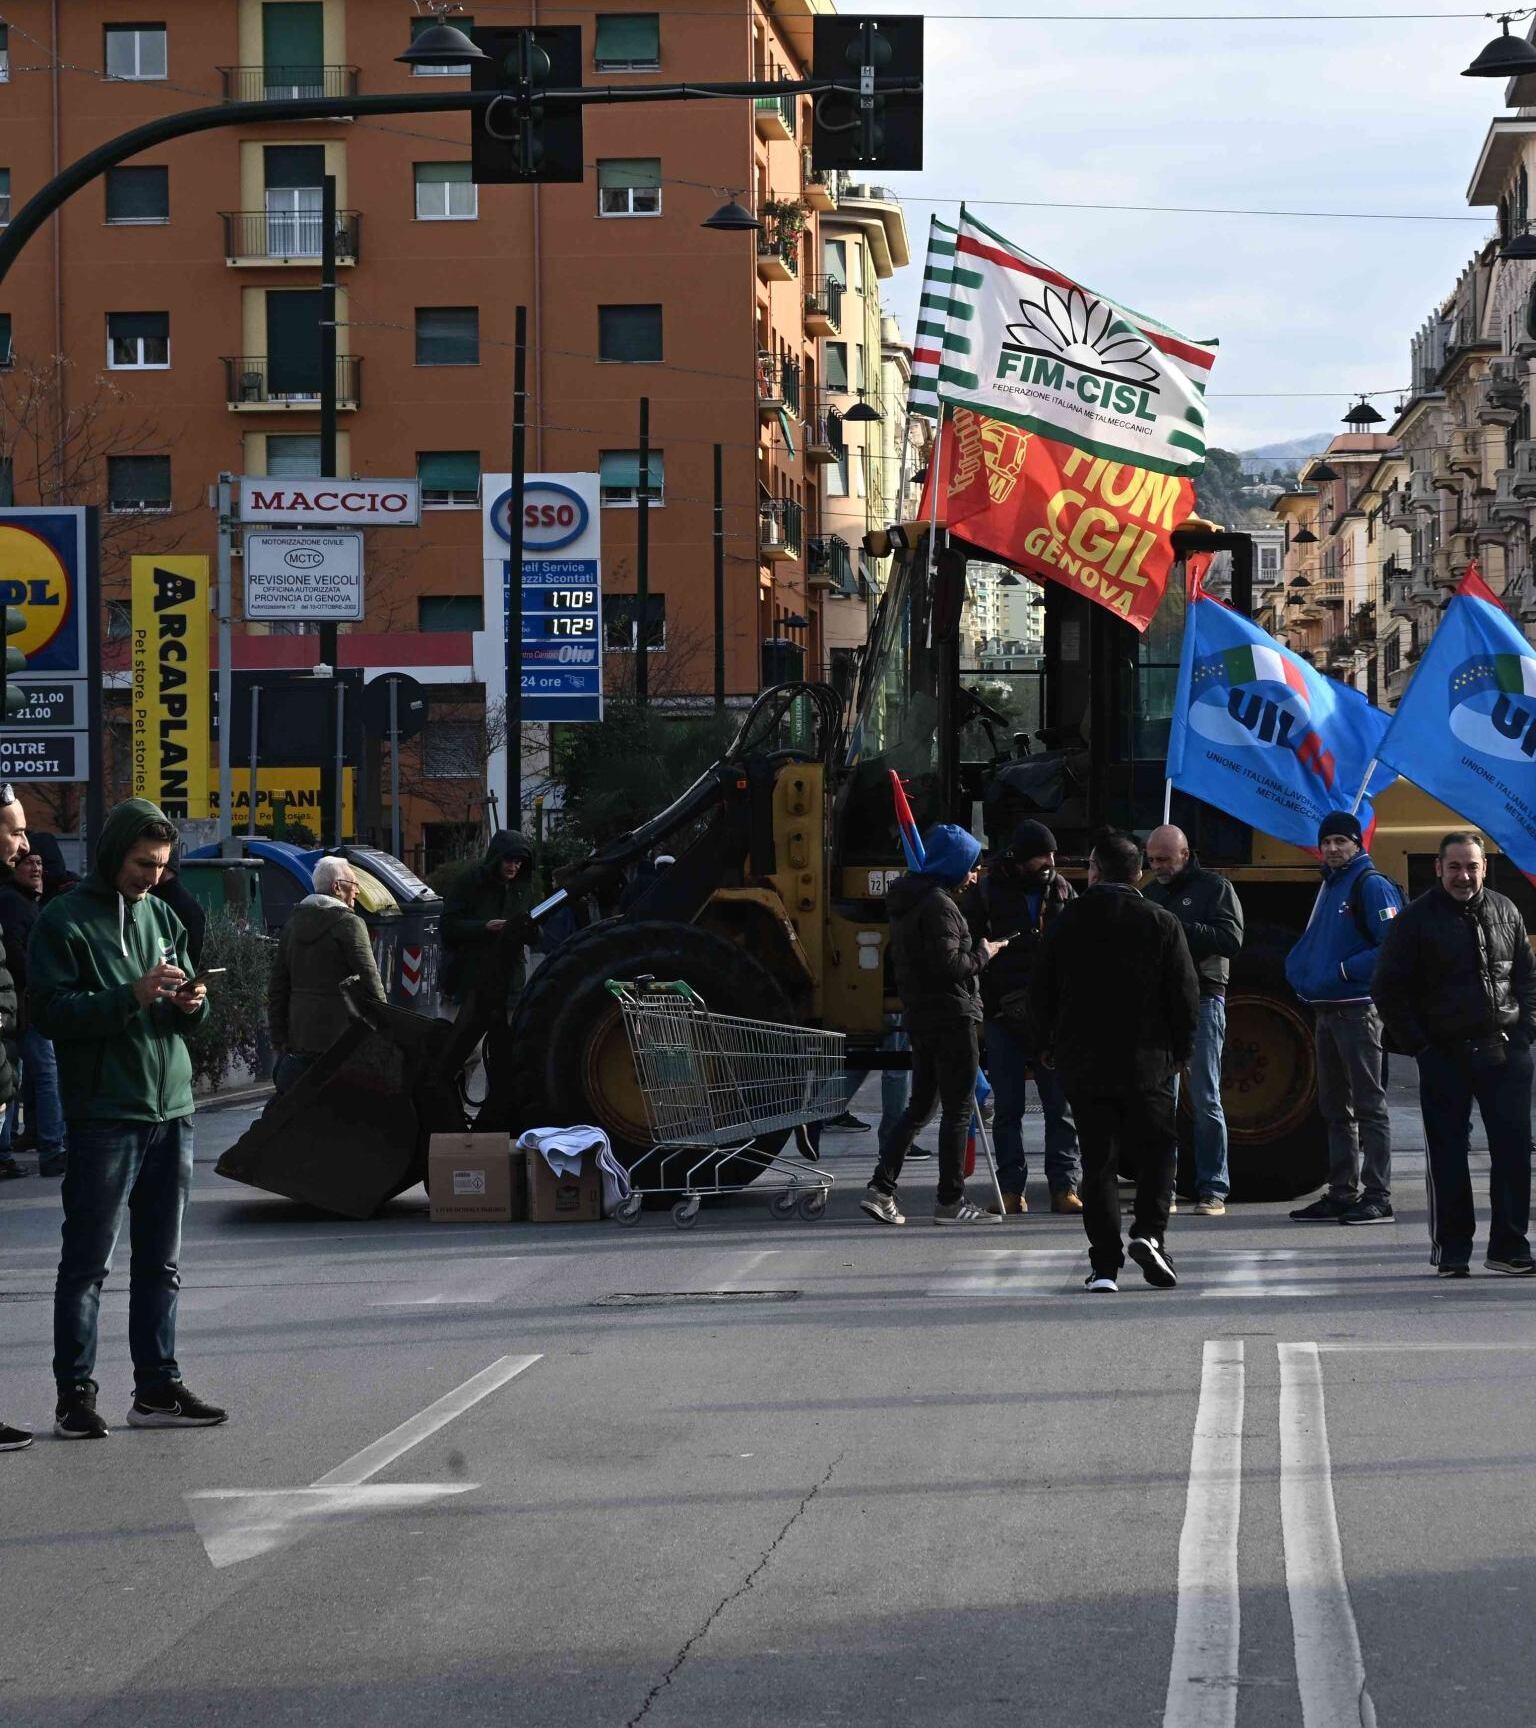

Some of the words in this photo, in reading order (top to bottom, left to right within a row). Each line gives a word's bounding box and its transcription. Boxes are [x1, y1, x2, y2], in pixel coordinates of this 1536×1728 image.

[996, 351, 1157, 422] FIM-CISL
[992, 383, 1050, 402] FEDERAZIONE
[1051, 396, 1083, 416] ITALIANA
[1083, 410, 1153, 435] METALMECCANICI
[261, 538, 321, 546] MOTORIZZAZIONE
[323, 538, 344, 546] CIVILE
[1047, 489, 1158, 587] CGIL
[289, 553, 321, 563] MCTC
[542, 562, 585, 572] Service
[250, 575, 311, 586] REVISIONE
[314, 575, 358, 586] VEICOLI
[545, 573, 594, 584] Scontati
[1024, 527, 1133, 615] GENOVA
[254, 594, 302, 602] PROVINCIA
[304, 594, 313, 602] DI
[315, 594, 351, 602] GENOVA
[135, 629, 146, 653] Pet
[135, 660, 147, 703] store.
[153, 567, 196, 819] ARCAPLANE
[540, 678, 561, 687] ore
[30, 692, 64, 704] 21.00
[16, 707, 51, 719] 21.00
[135, 709, 147, 734] Pet
[1, 743, 46, 755] OLTRE
[1227, 687, 1335, 791] UILM
[15, 760, 59, 773] POSTI
[135, 740, 148, 796] stories.
[1205, 750, 1242, 774] UNIONE
[1243, 767, 1283, 793] ITALIANA
[1460, 756, 1496, 785] UNIONE
[1496, 780, 1529, 813] ITALIANA
